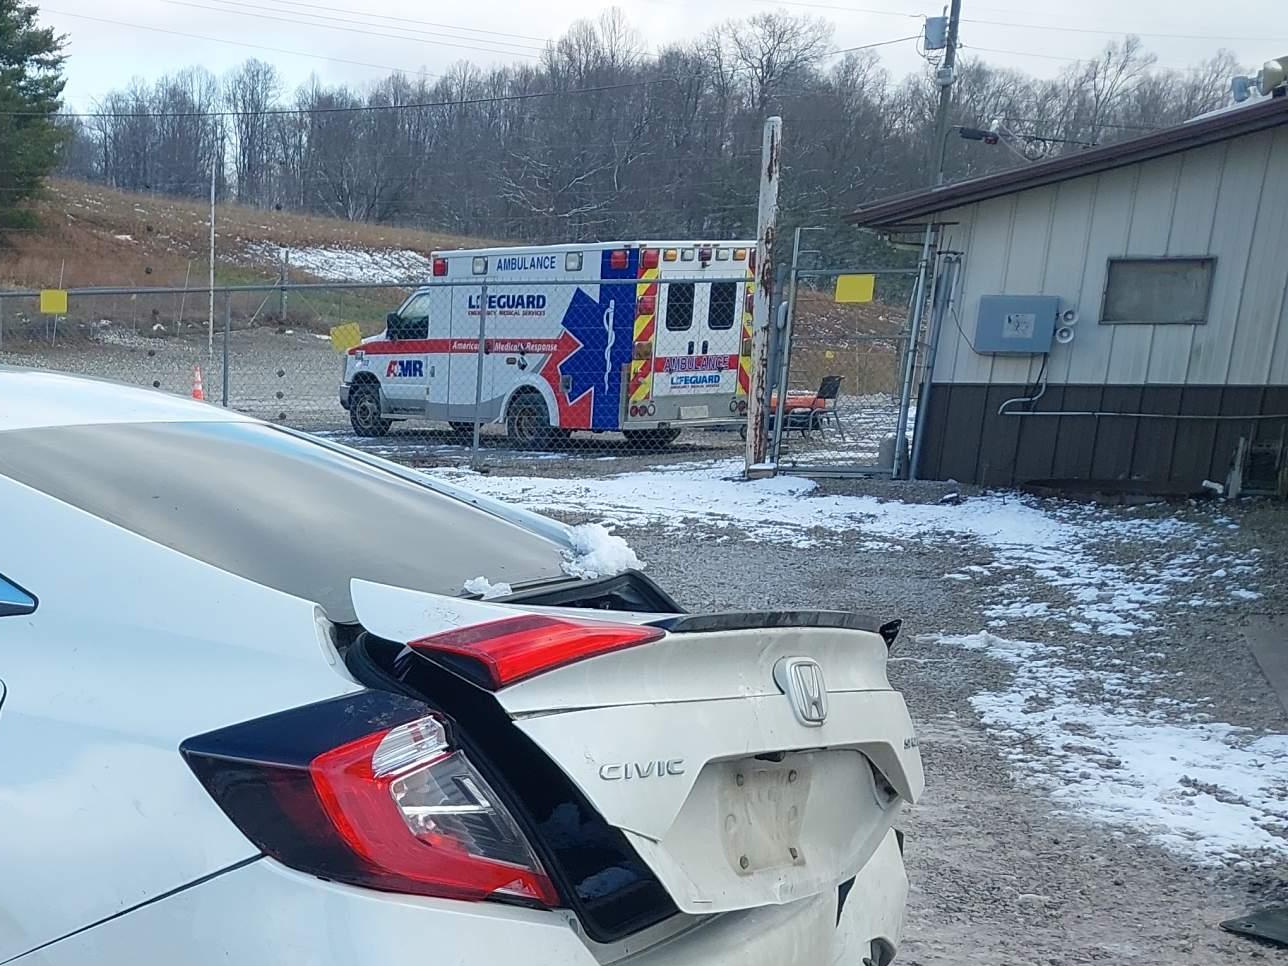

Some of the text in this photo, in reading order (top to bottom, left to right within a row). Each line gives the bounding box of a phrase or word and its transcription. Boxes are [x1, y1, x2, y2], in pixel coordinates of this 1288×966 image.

[497, 256, 557, 271] AMBULANCE
[526, 342, 558, 352] Response
[386, 360, 423, 377] AMR
[664, 356, 729, 373] AMBULANCE
[599, 760, 685, 781] CIVIC
